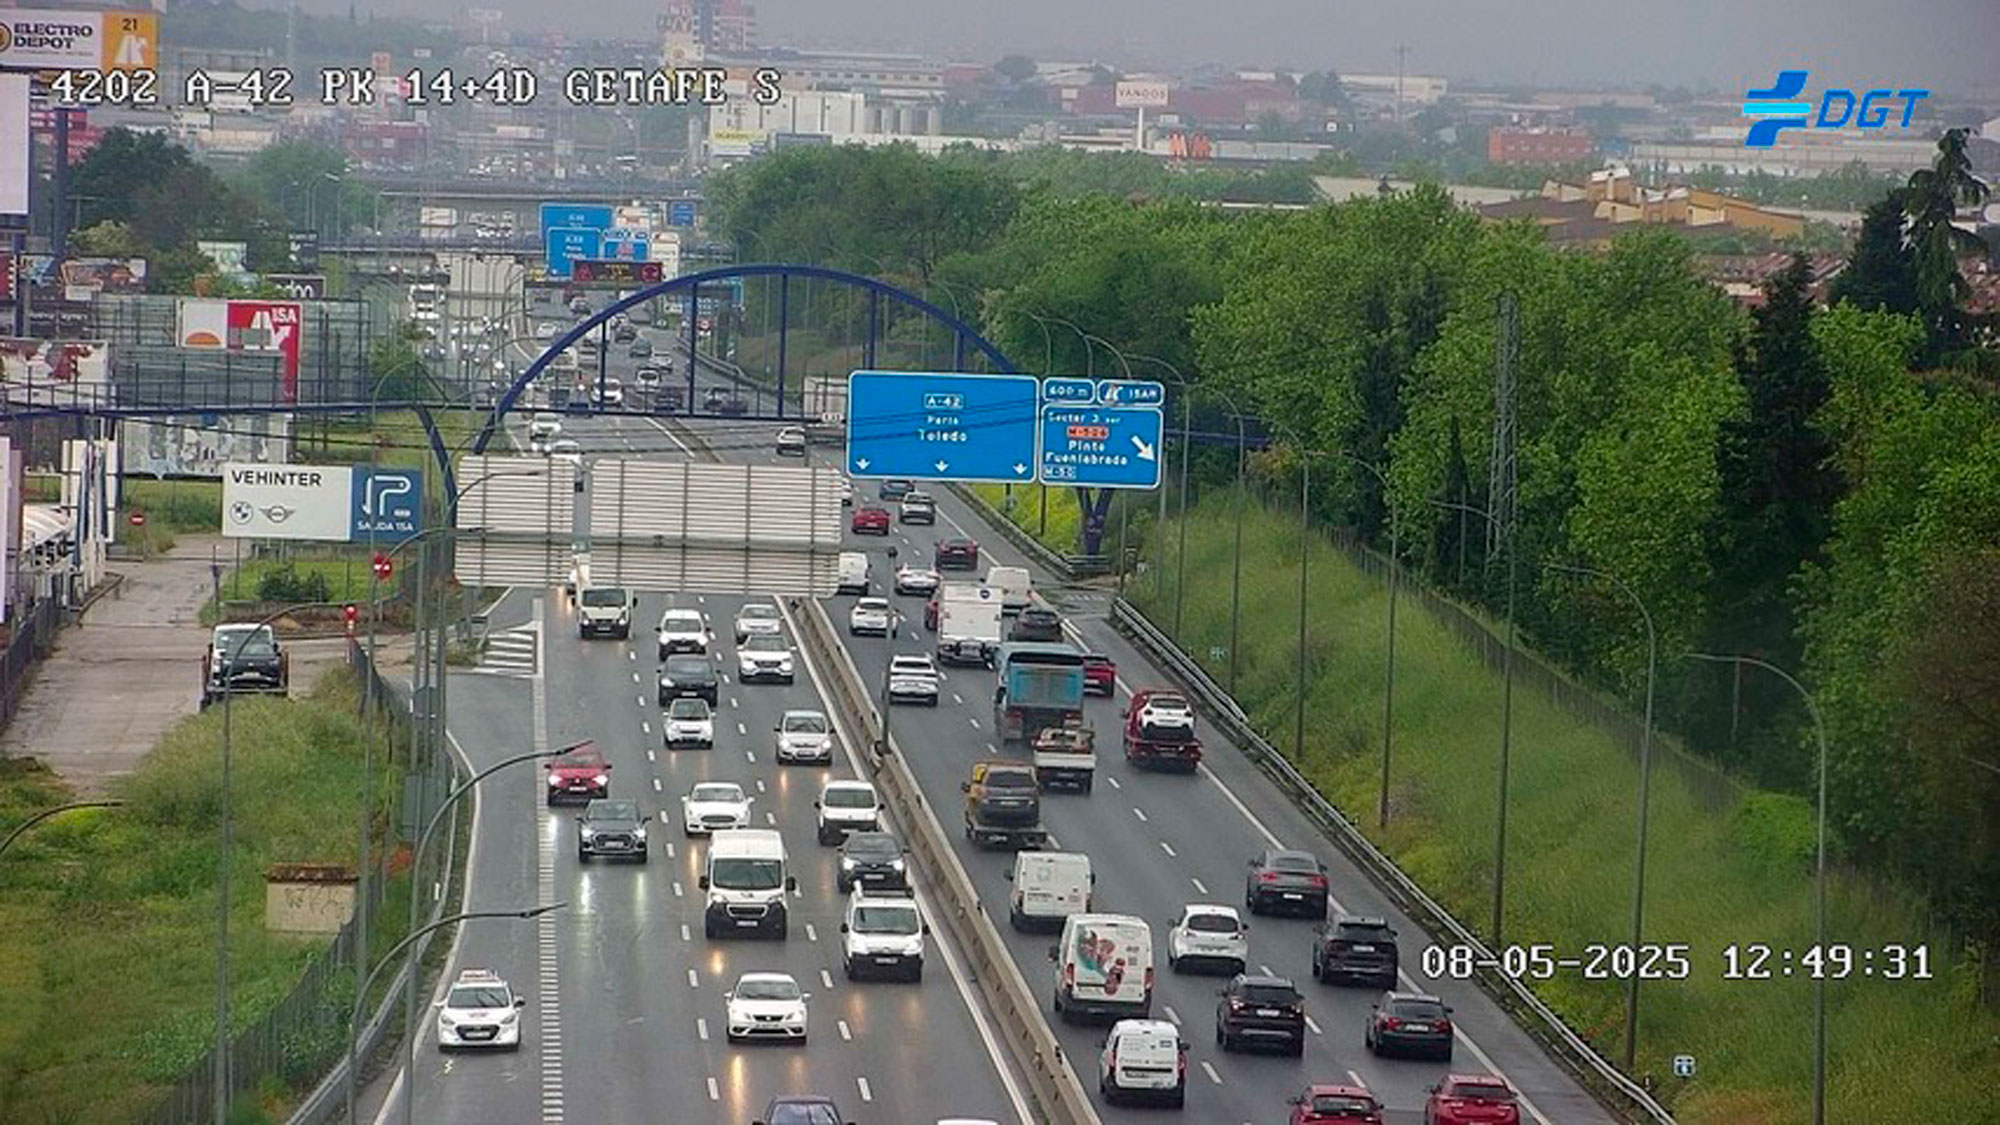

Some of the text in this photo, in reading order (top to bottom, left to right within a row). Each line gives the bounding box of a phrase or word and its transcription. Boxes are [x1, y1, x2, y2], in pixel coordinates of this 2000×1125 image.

[14, 23, 93, 37] ELECTRO
[122, 18, 138, 31] 21
[14, 36, 74, 49] DEPOT
[928, 396, 962, 407] A-42
[918, 429, 967, 442] Toledo
[231, 470, 322, 487] VEHINTER
